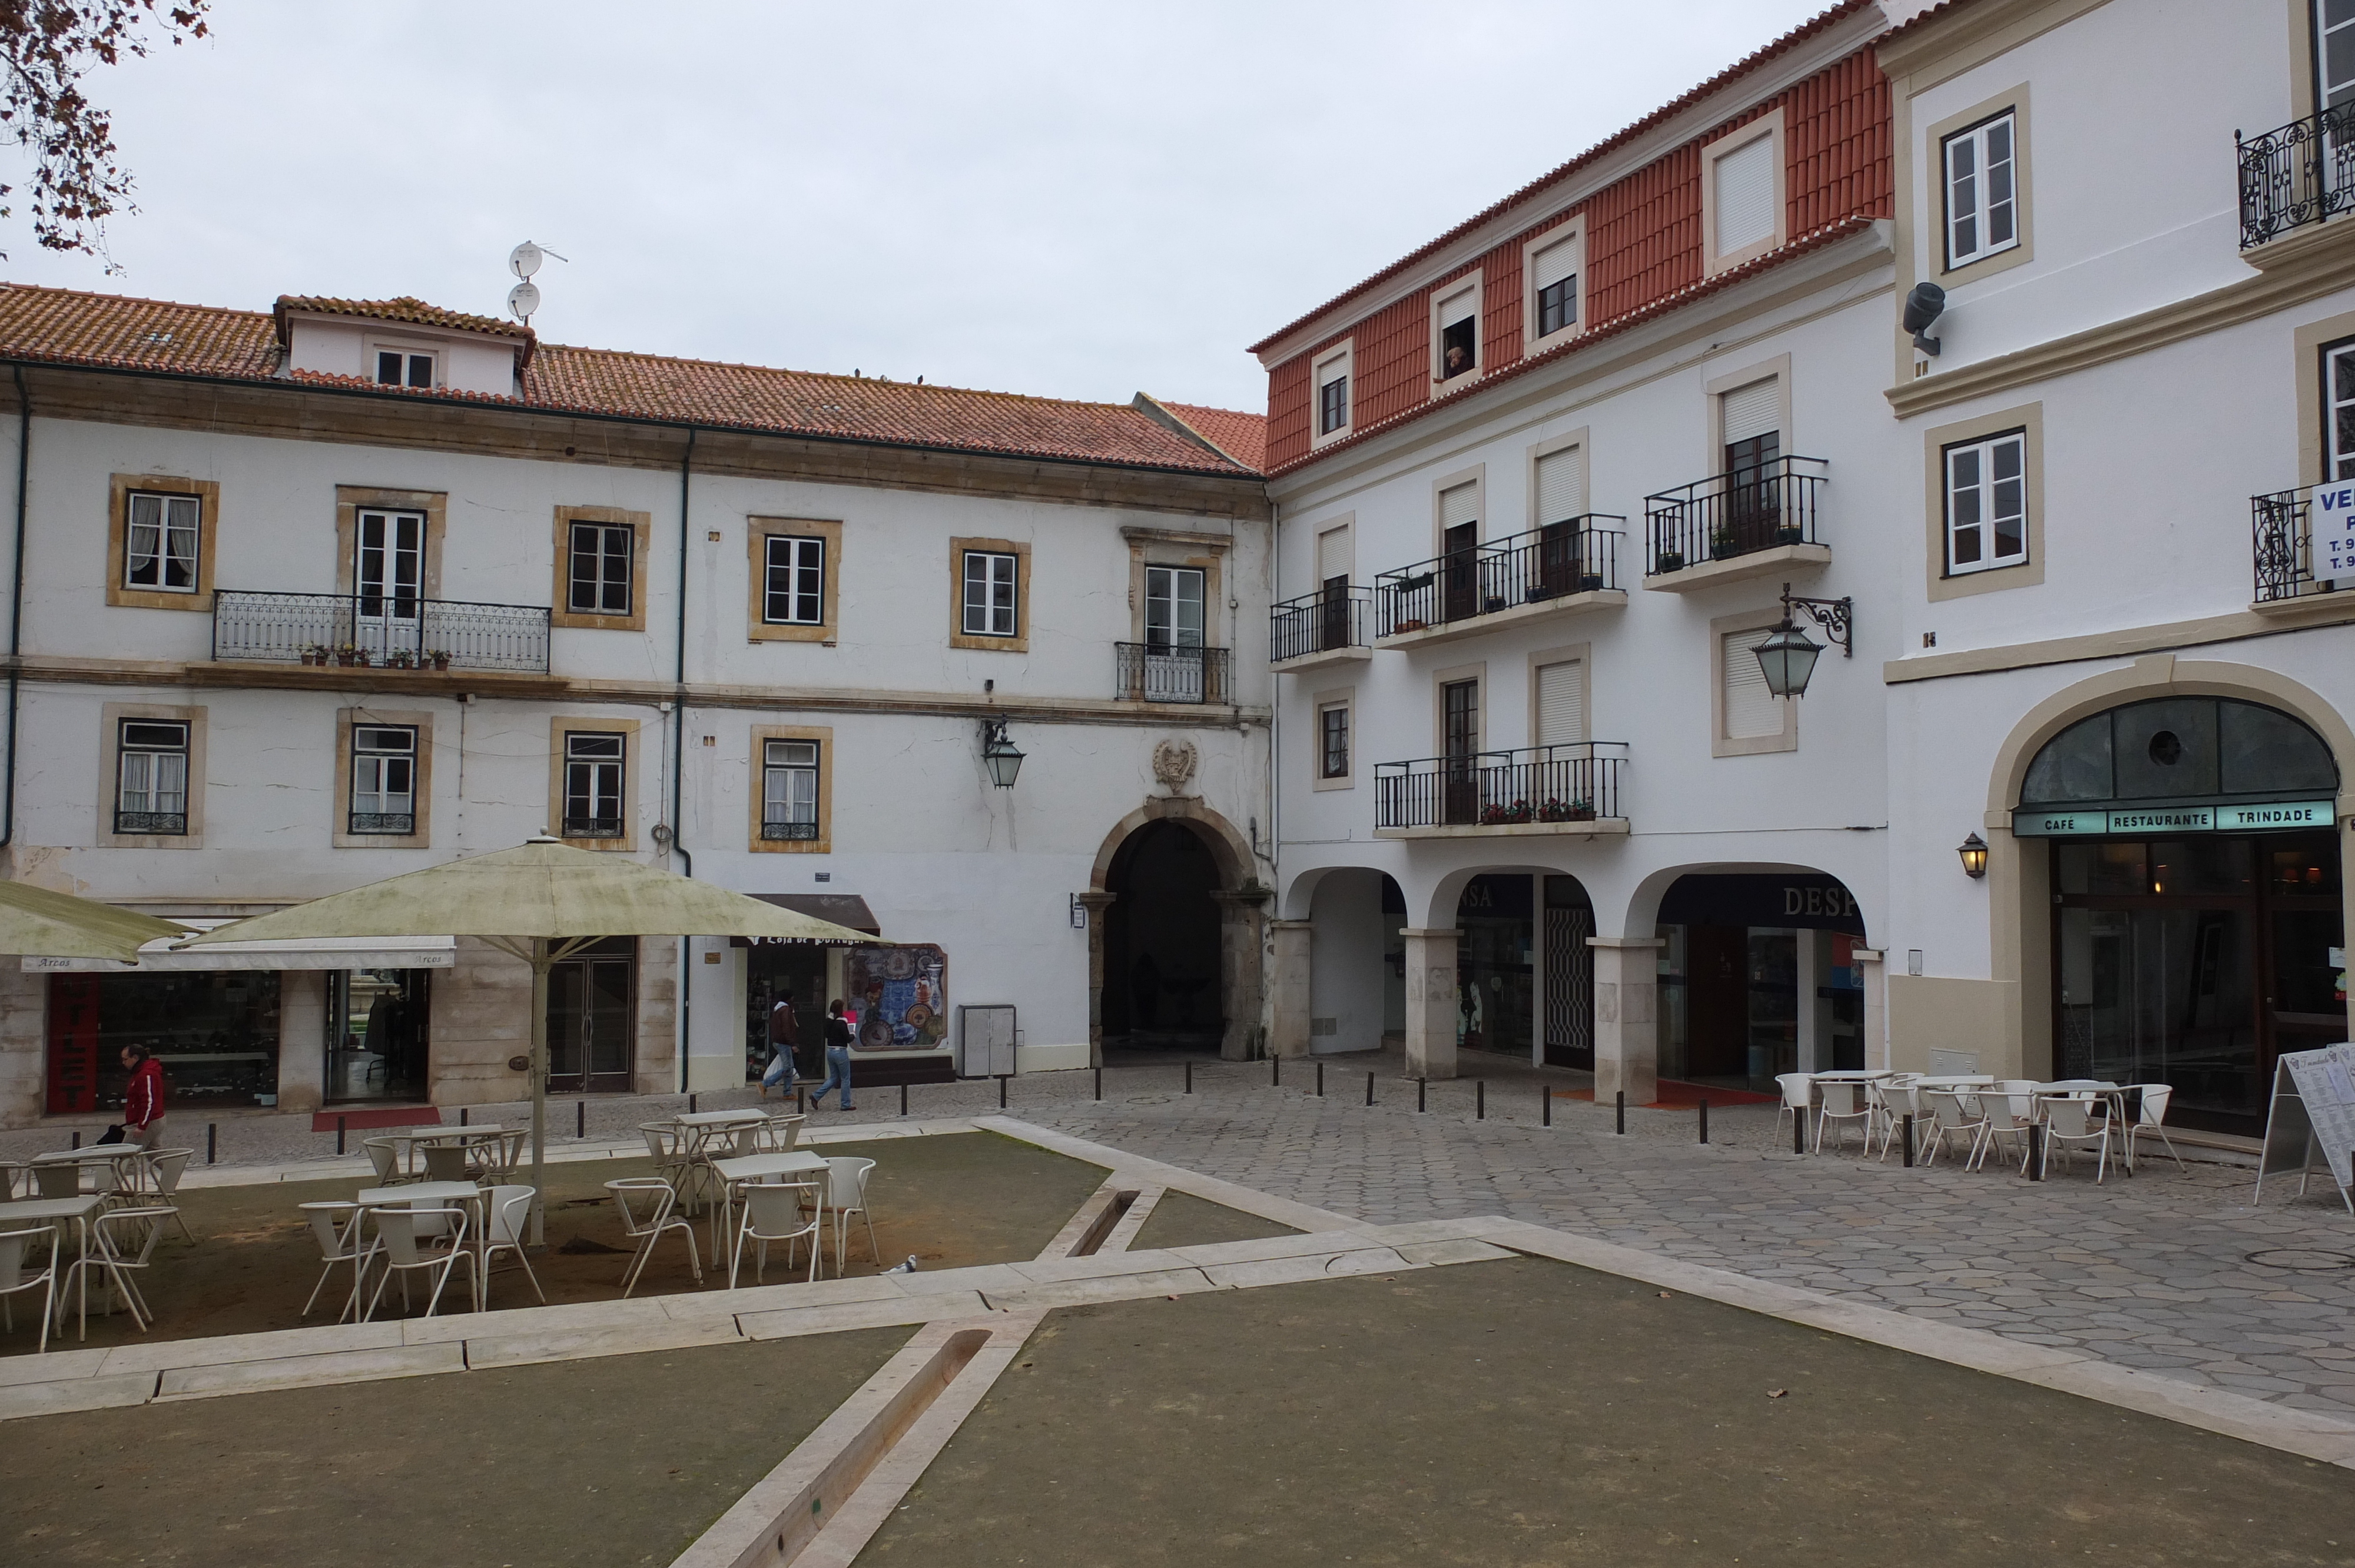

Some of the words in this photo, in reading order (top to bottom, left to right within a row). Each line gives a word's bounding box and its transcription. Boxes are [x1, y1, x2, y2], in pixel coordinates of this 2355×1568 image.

[2320, 489, 2355, 511] VE
[2329, 540, 2341, 552] T.
[2330, 557, 2342, 569] T.
[2045, 816, 2074, 830] CAFÉ
[2114, 813, 2208, 828] RESTAURANTE
[2237, 809, 2312, 823] TRINDADE
[38, 958, 70, 967] Arcos
[59, 977, 90, 1109] UTLET
